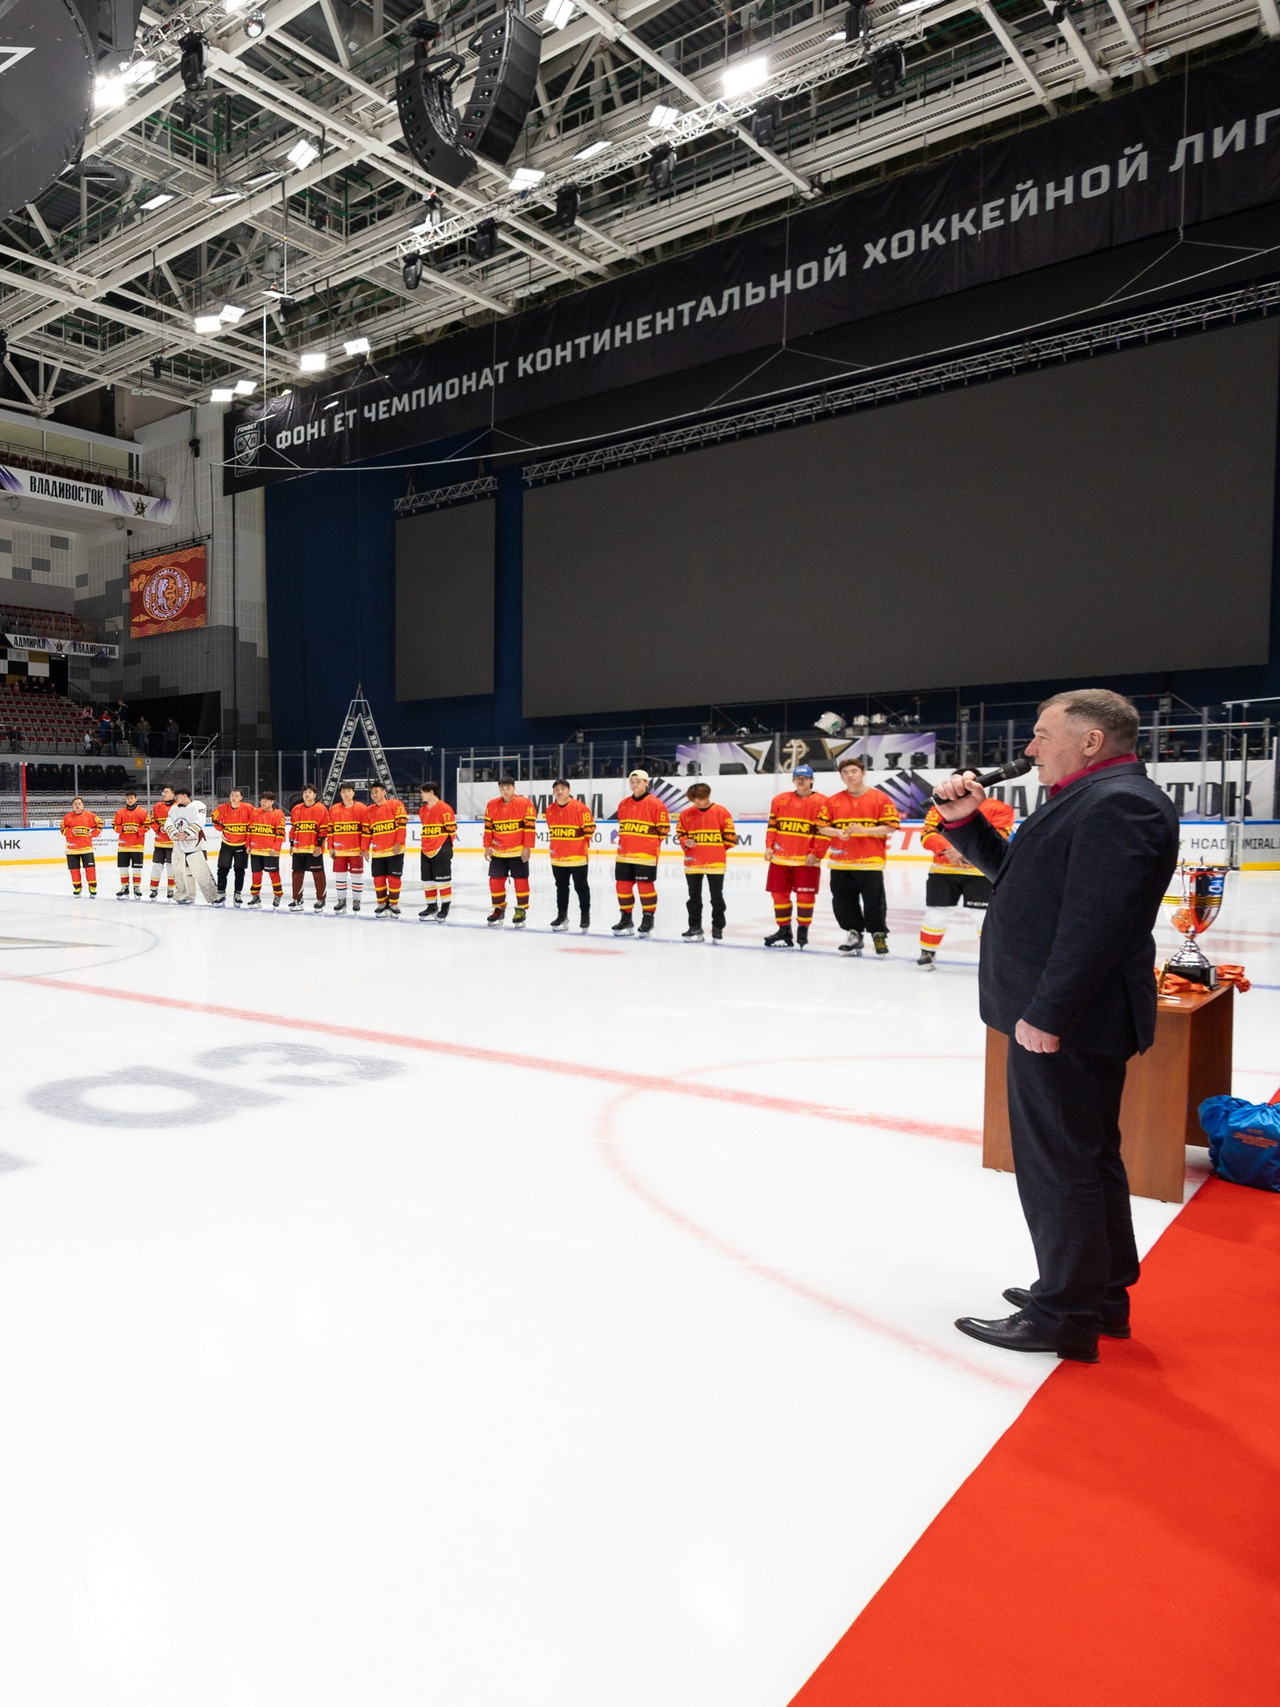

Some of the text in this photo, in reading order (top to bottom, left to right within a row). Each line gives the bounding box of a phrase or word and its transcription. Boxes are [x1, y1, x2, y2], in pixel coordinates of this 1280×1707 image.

[363, 361, 510, 423] ЧЕМПИОНАТ
[517, 243, 848, 378] КОНТИНЕНТАЛЬНОЙ
[863, 142, 1149, 271] ХОККЕЙНОЙ
[29, 475, 104, 507] ВЛАДИВОСТОК
